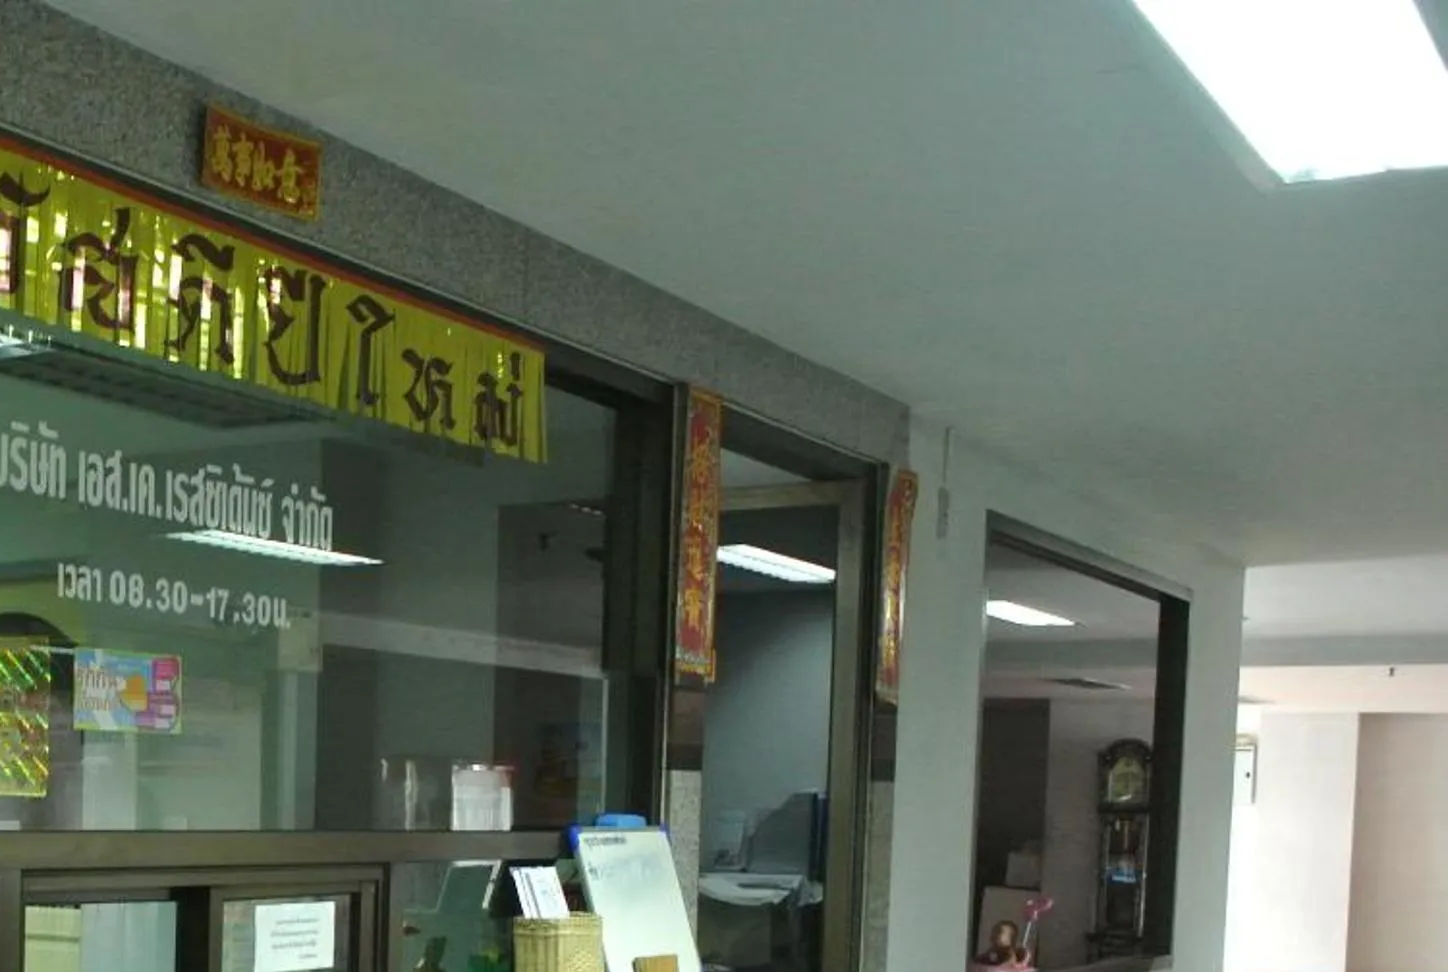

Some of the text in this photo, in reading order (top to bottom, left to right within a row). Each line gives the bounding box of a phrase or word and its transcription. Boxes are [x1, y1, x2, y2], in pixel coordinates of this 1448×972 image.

[211, 123, 305, 204] 萬事如意
[281, 483, 333, 552] จำกัด
[57, 563, 102, 602] เวลา
